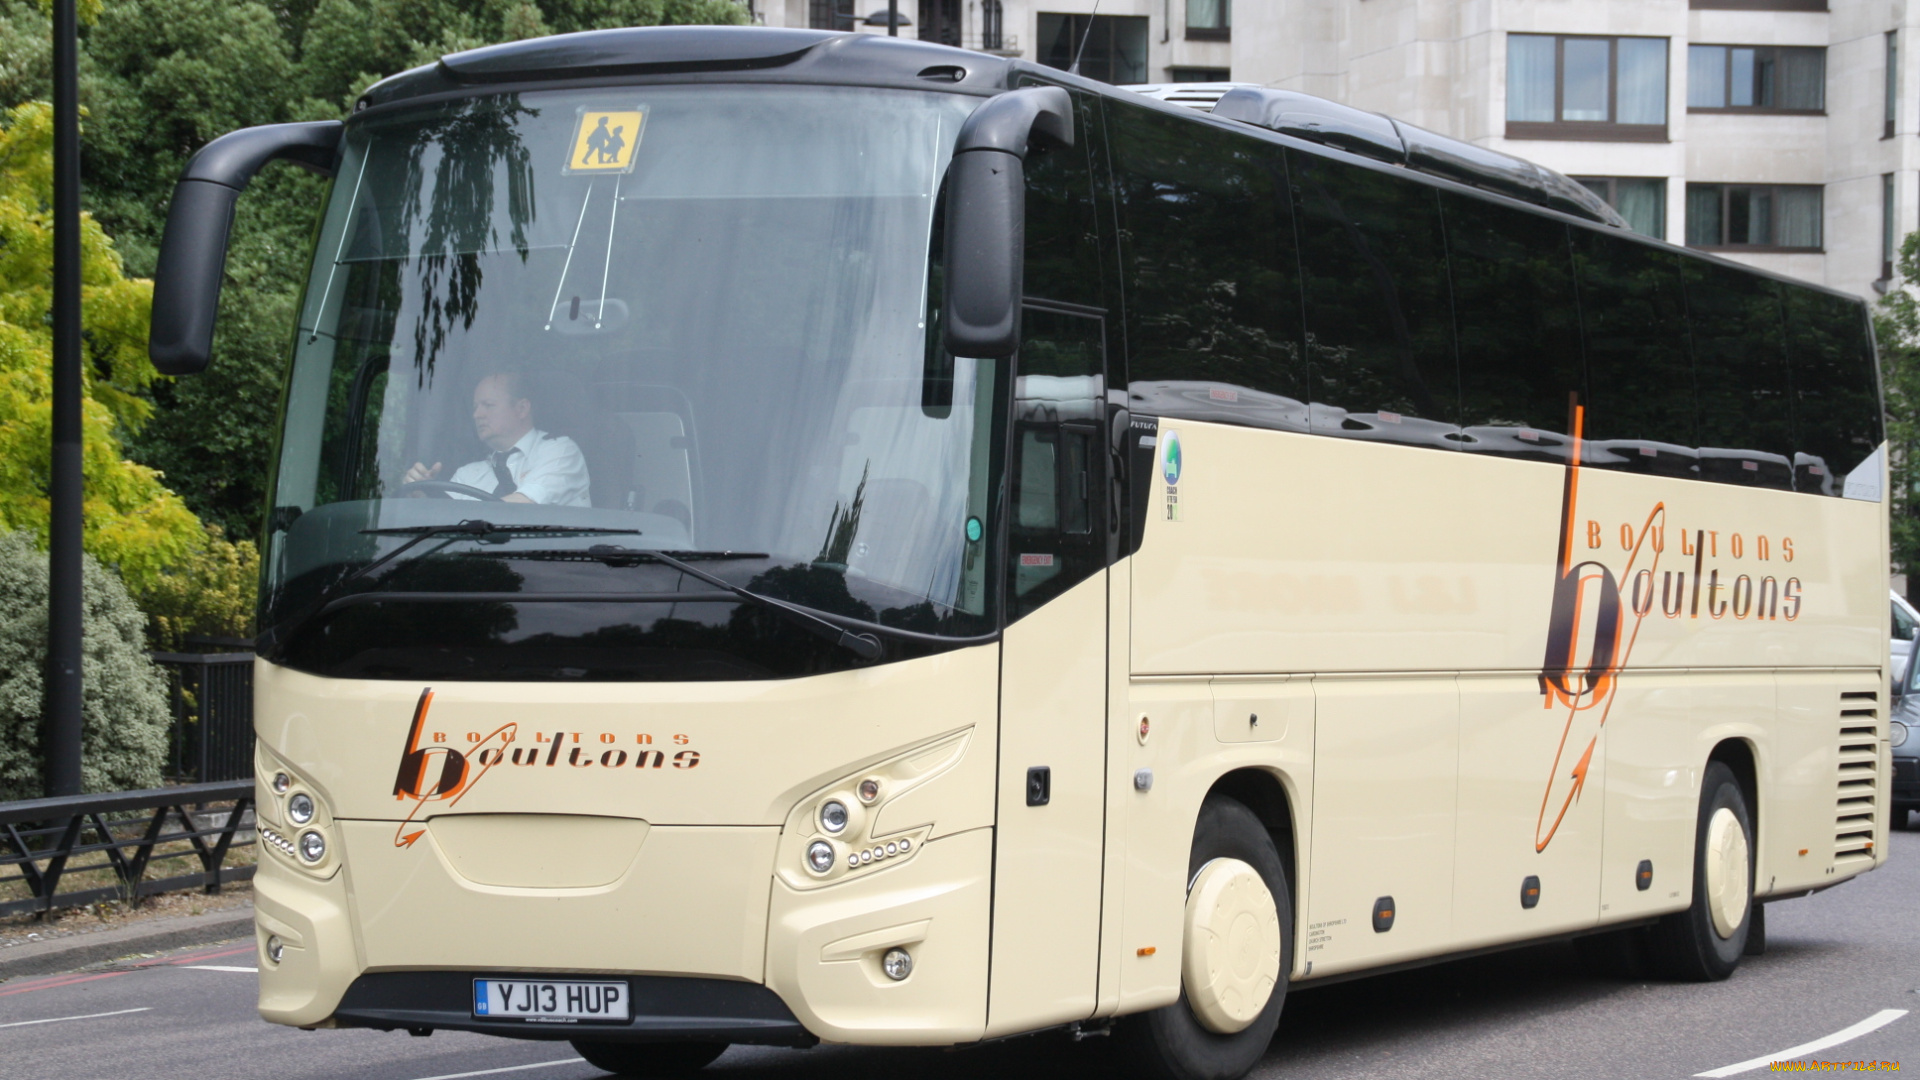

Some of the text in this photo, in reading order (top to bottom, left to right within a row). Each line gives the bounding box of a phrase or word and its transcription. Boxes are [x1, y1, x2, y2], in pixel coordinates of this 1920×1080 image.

[392, 687, 701, 801] boultons
[477, 1002, 487, 1011] GB
[497, 983, 620, 1014] YJ13 HUP
